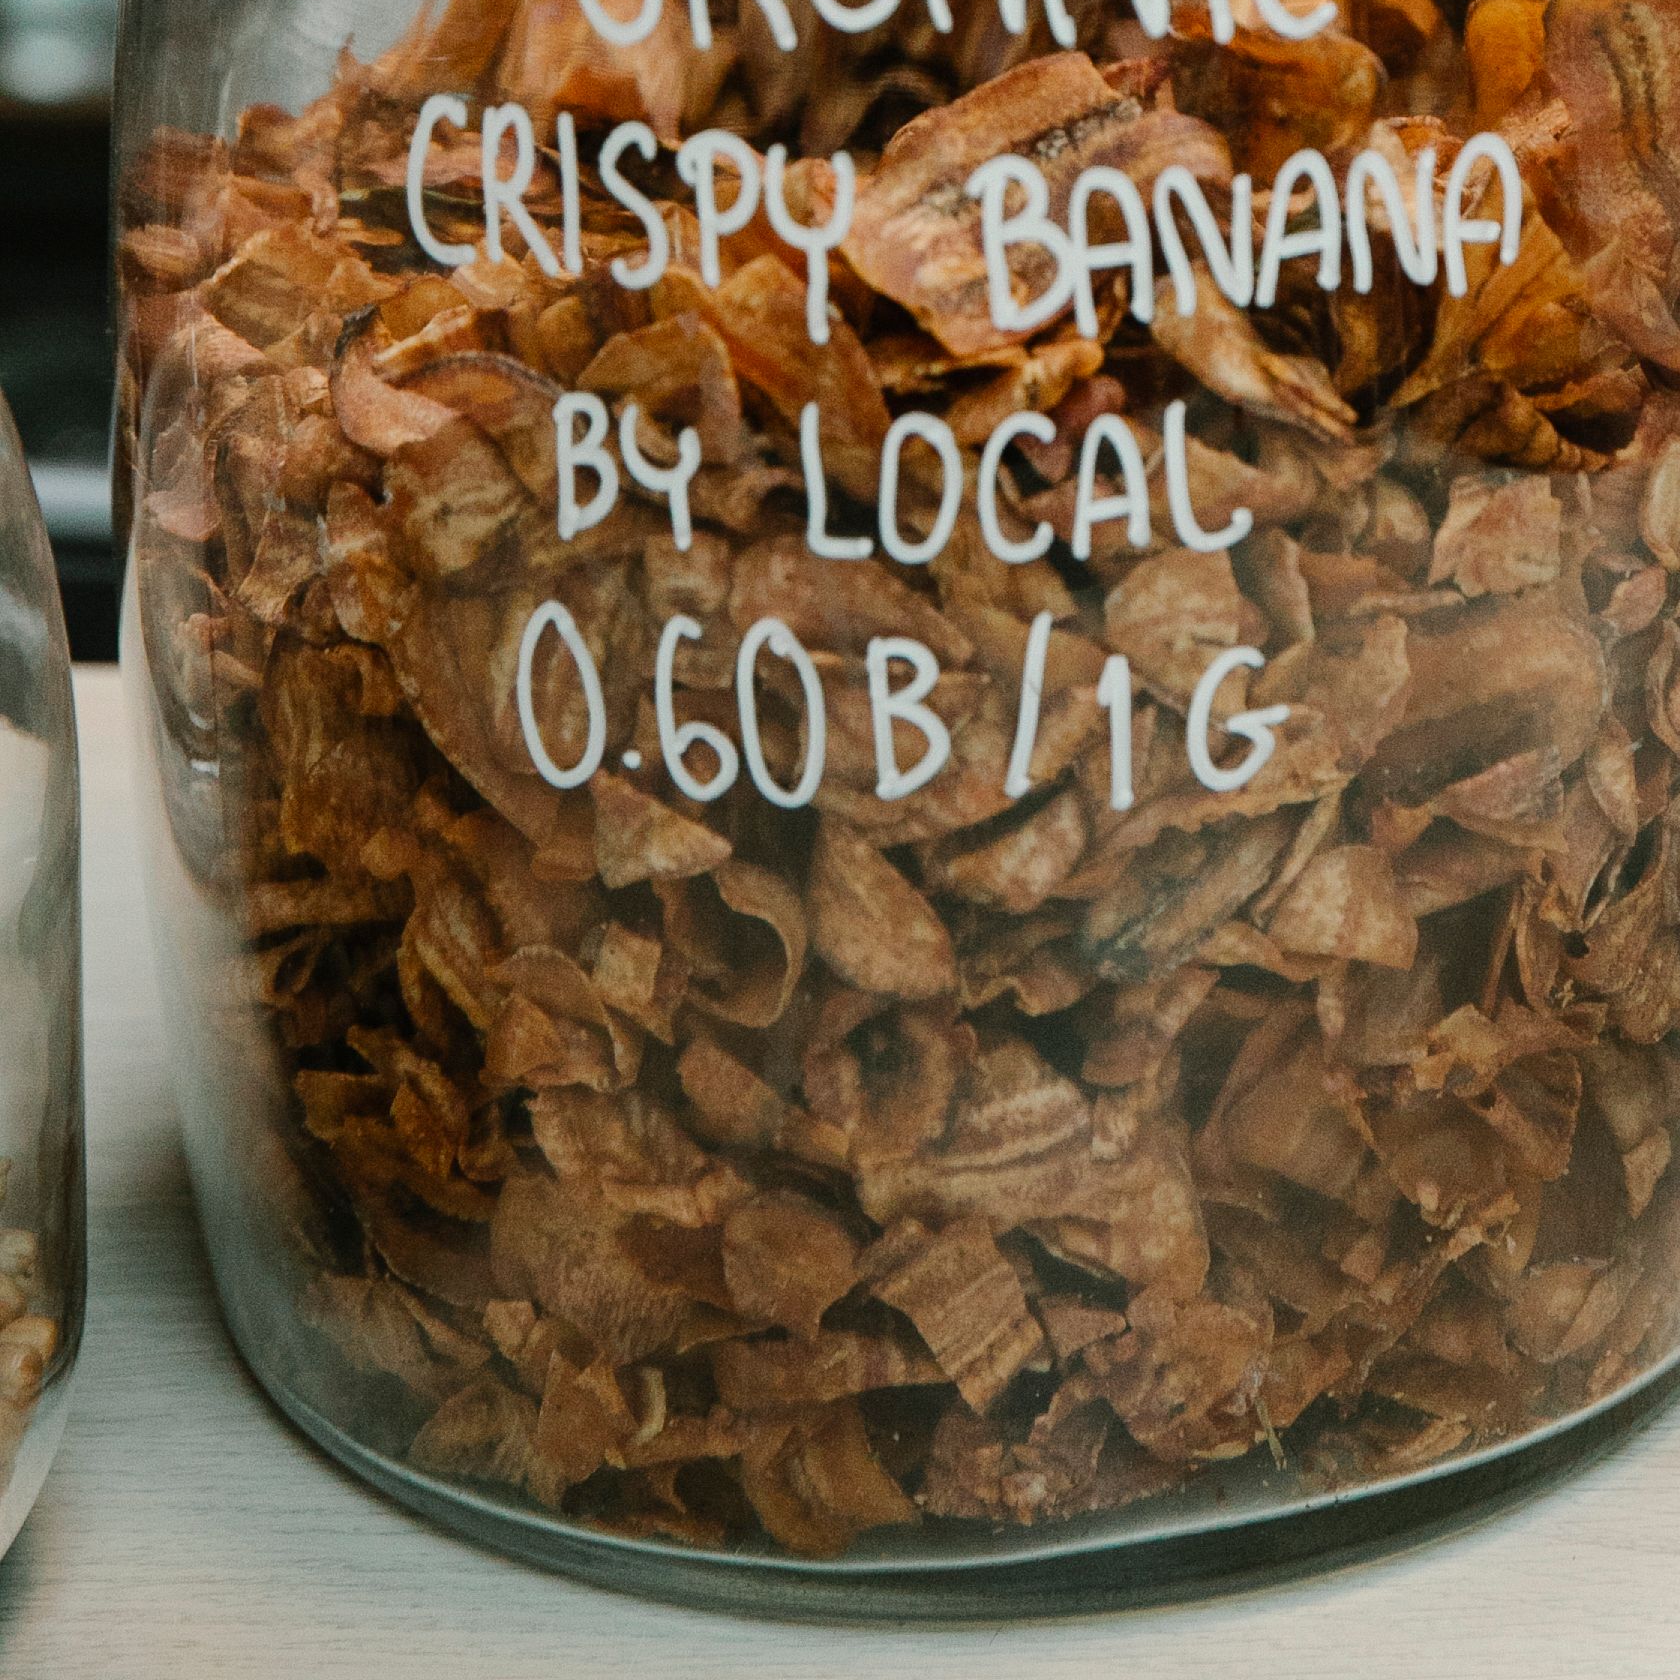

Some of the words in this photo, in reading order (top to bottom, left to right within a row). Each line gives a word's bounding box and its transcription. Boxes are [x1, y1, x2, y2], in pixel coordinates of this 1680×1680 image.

[406, 93, 857, 345] CRISPY
[968, 131, 1523, 341] BANANA
[552, 392, 700, 553] BY
[801, 399, 1254, 566] LOCAL
